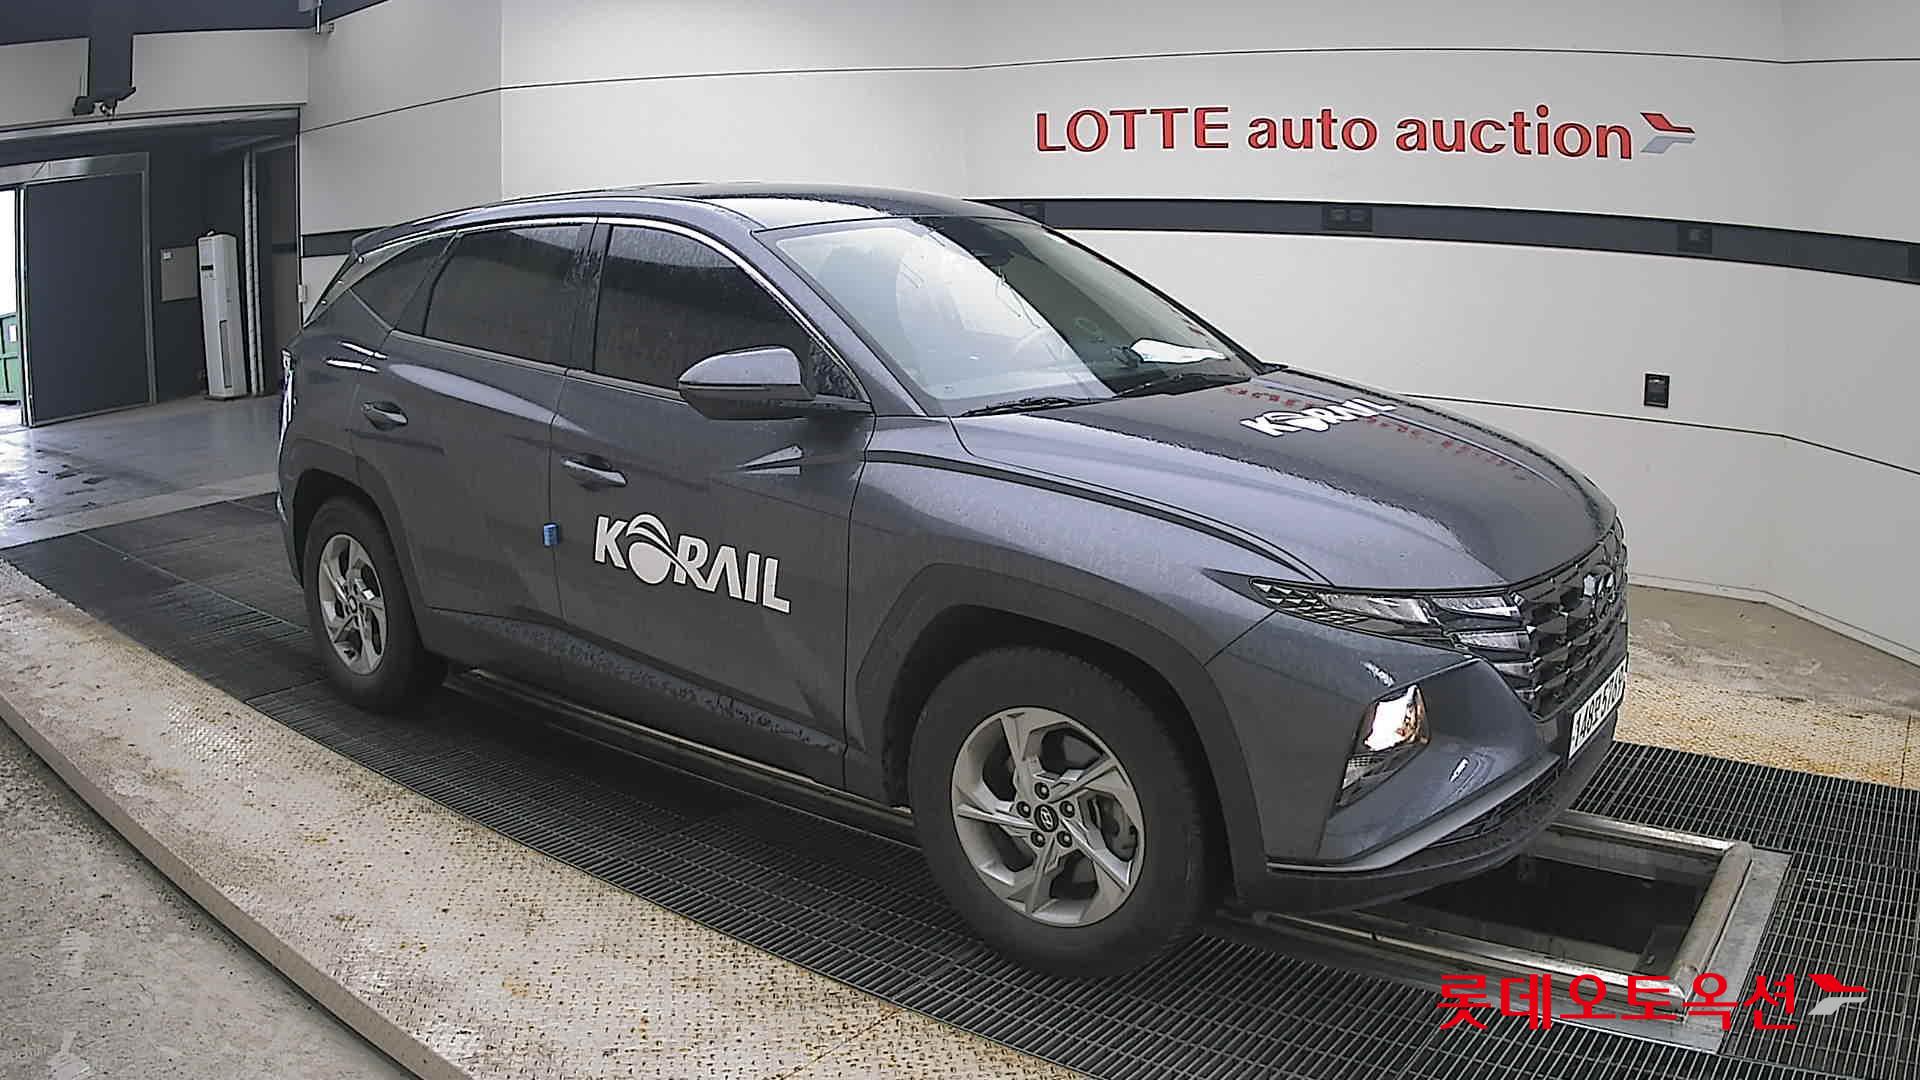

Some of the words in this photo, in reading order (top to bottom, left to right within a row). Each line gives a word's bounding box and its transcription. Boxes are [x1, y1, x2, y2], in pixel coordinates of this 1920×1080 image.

[1037, 105, 1229, 153] LOTTE
[1248, 108, 1377, 151] auto
[1395, 105, 1632, 159] auction
[593, 513, 791, 613] KORAIL
